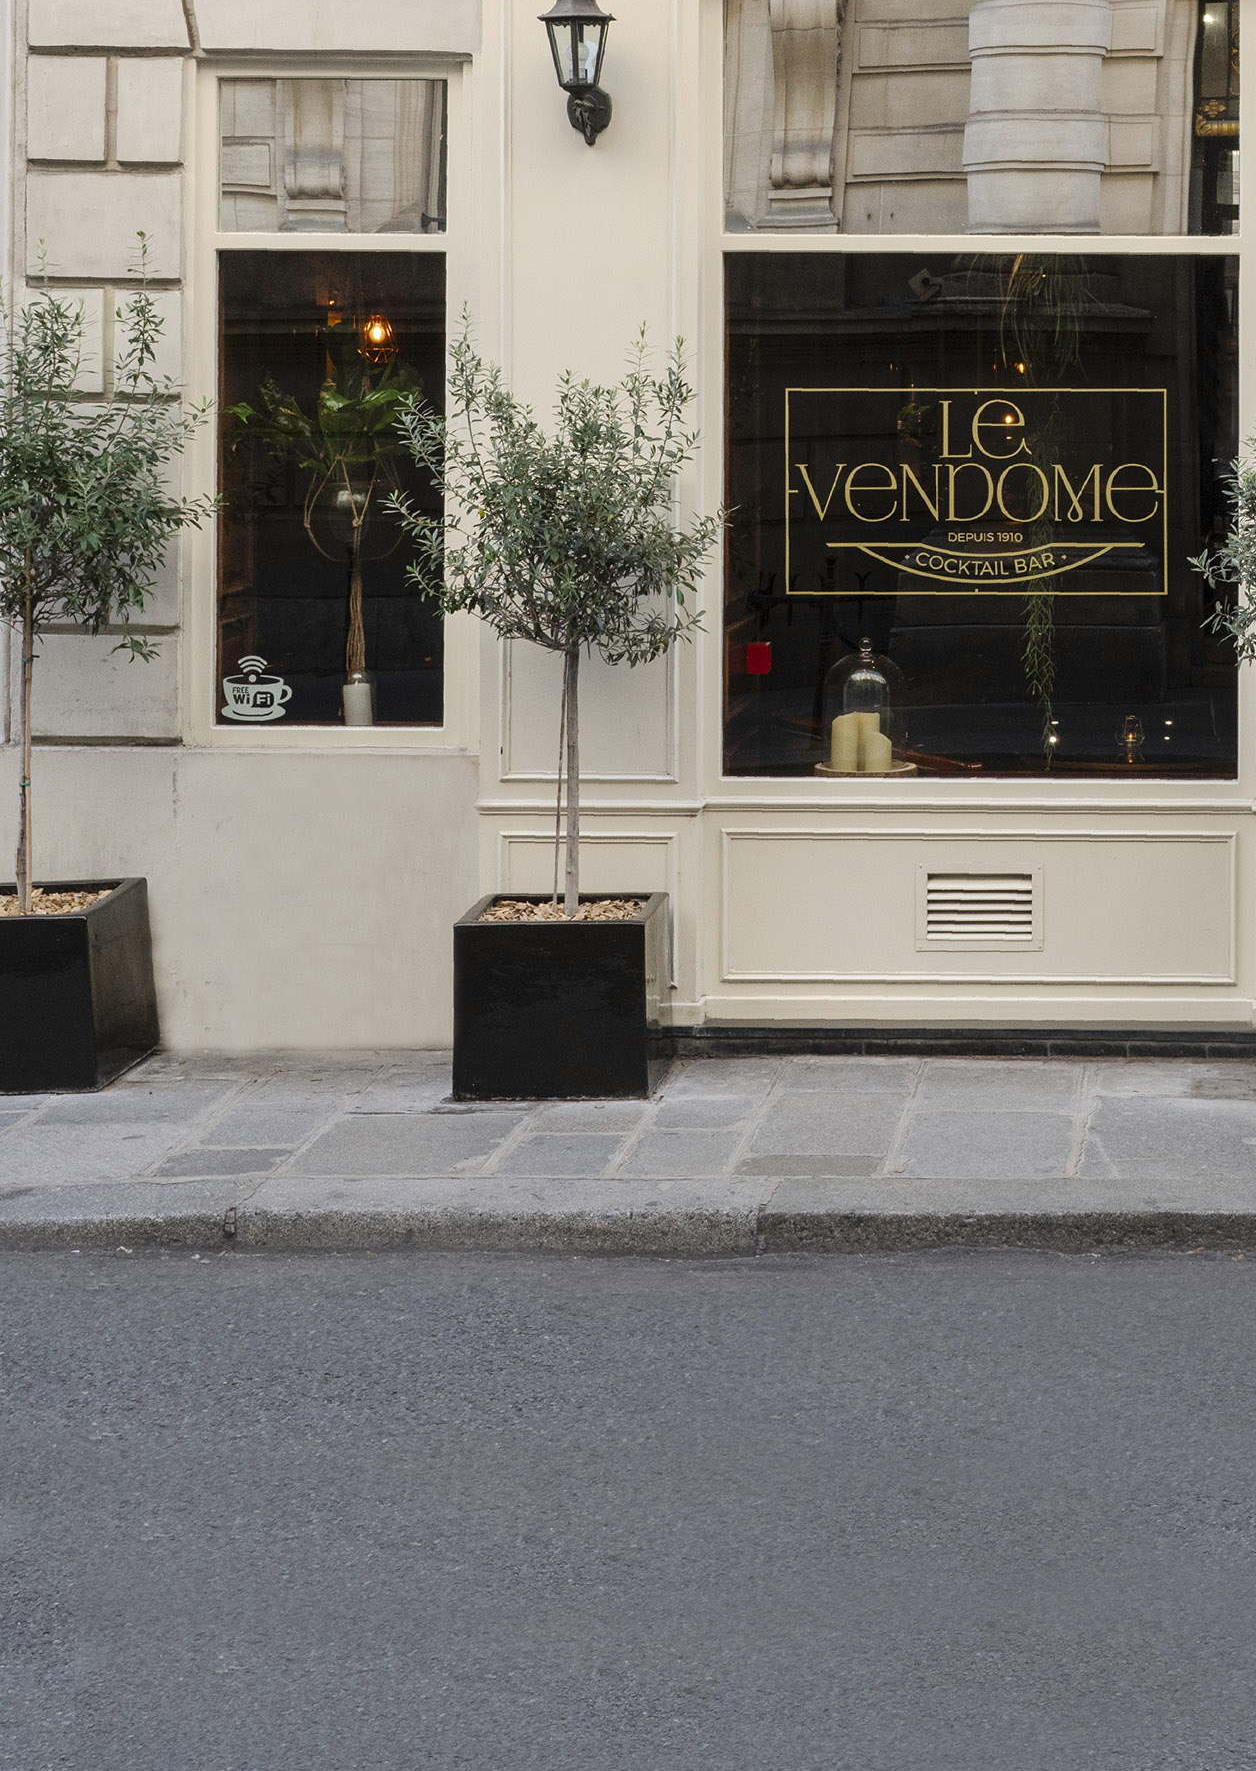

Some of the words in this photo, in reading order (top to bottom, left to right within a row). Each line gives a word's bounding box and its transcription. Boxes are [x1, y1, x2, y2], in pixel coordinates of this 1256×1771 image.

[947, 532, 994, 543] DEPUIS
[996, 532, 1023, 543] 1910
[915, 552, 1010, 576] COCKTAIL
[1014, 552, 1056, 574] BAR
